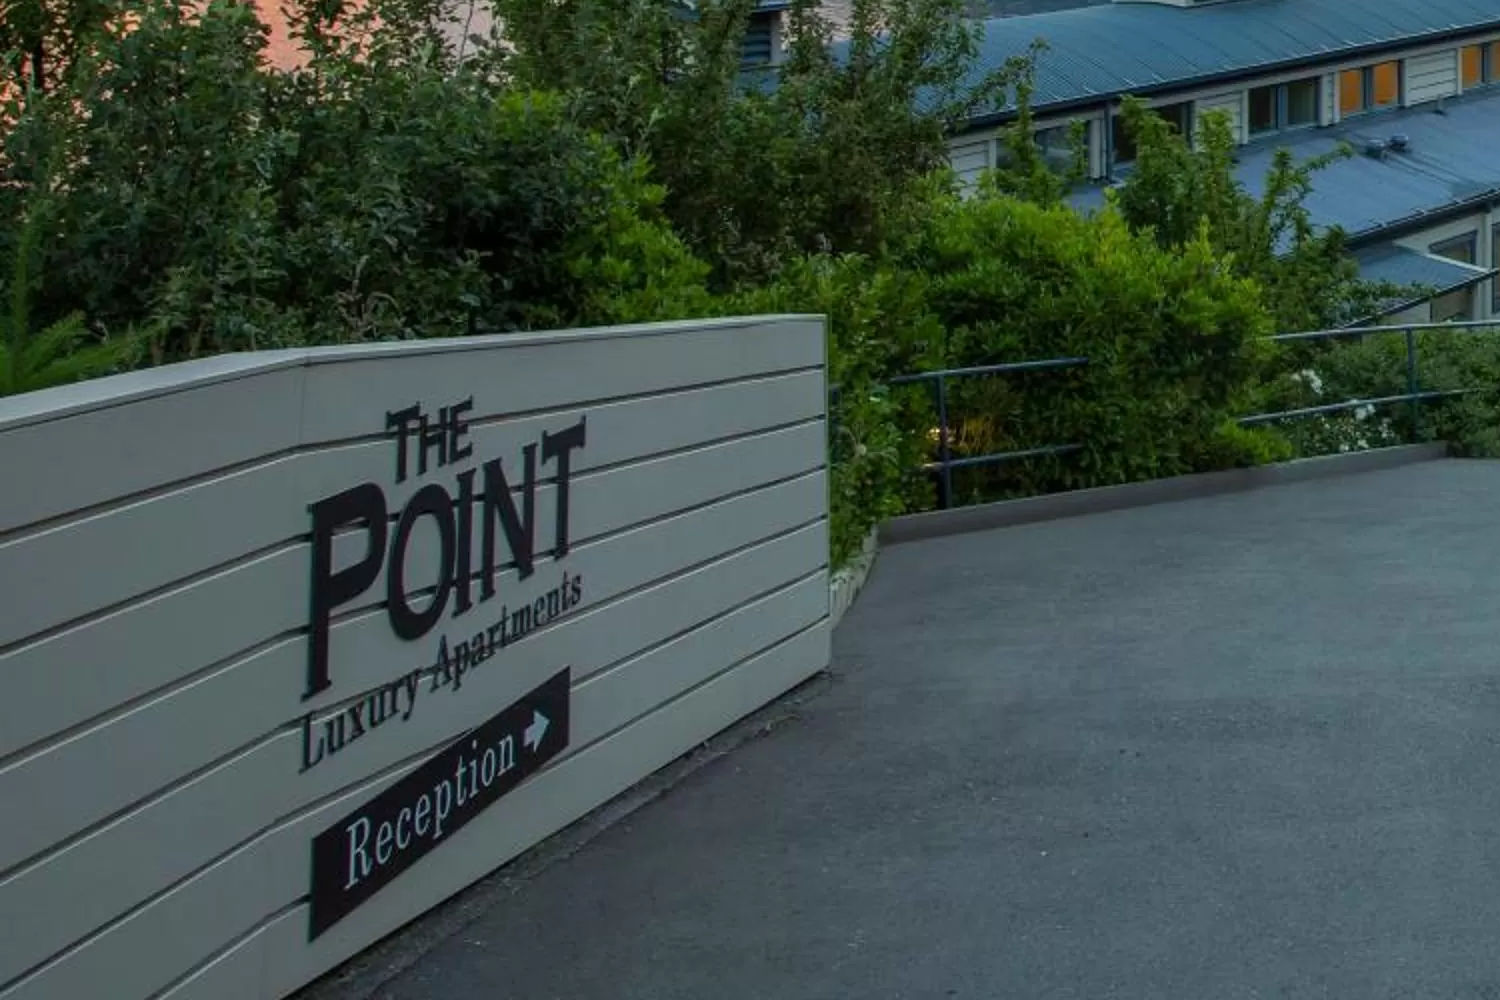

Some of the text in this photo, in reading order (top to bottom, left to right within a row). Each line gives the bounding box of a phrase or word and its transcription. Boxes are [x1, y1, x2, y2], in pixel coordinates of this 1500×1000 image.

[386, 396, 473, 484] THE
[301, 416, 586, 702] POINT
[299, 571, 582, 774] Luxury Apartments
[344, 729, 516, 892] Reception
